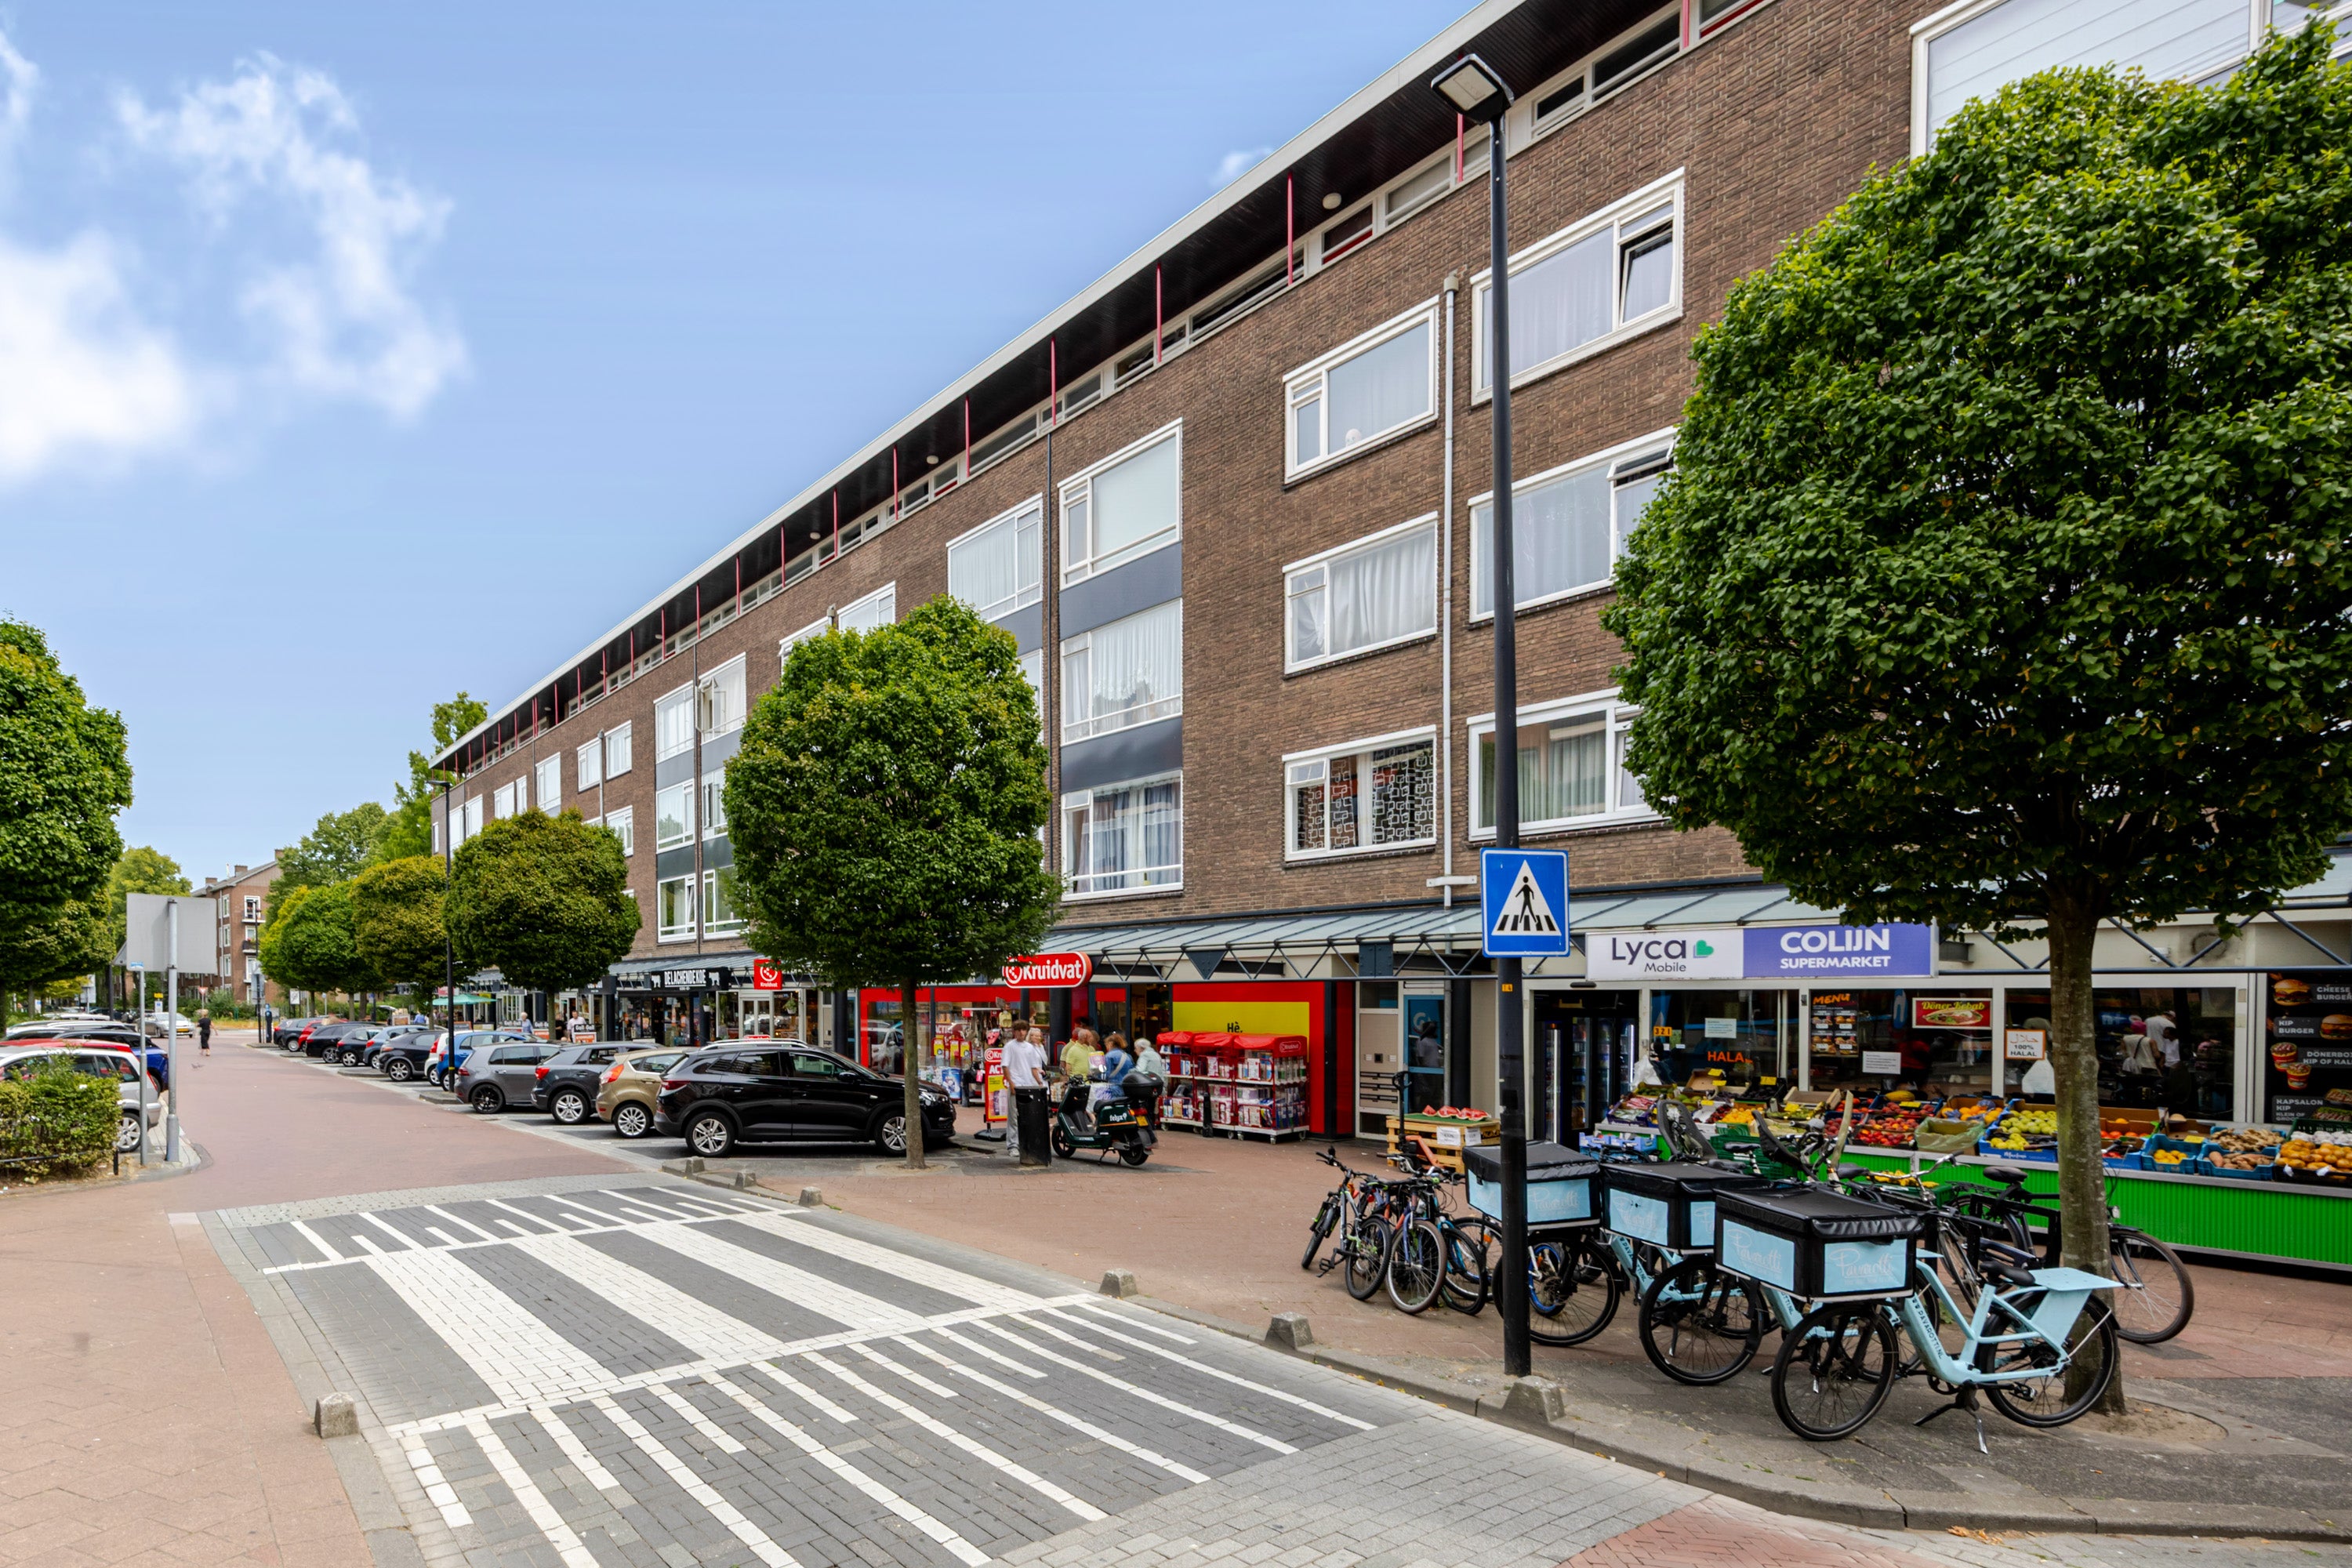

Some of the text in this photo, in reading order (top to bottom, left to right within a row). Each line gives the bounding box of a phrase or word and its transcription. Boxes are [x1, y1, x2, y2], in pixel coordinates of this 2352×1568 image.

[1780, 928, 1890, 953] COLIJN
[1611, 937, 1686, 965] Lyca
[1644, 962, 1686, 972] Mobile
[1780, 955, 1891, 969] SUPERMARKET
[1023, 958, 1082, 980] Kruidvat
[1813, 993, 1851, 1004] MENU
[1922, 1001, 1985, 1011] Döner Kebab
[1707, 1051, 1753, 1063] HALA
